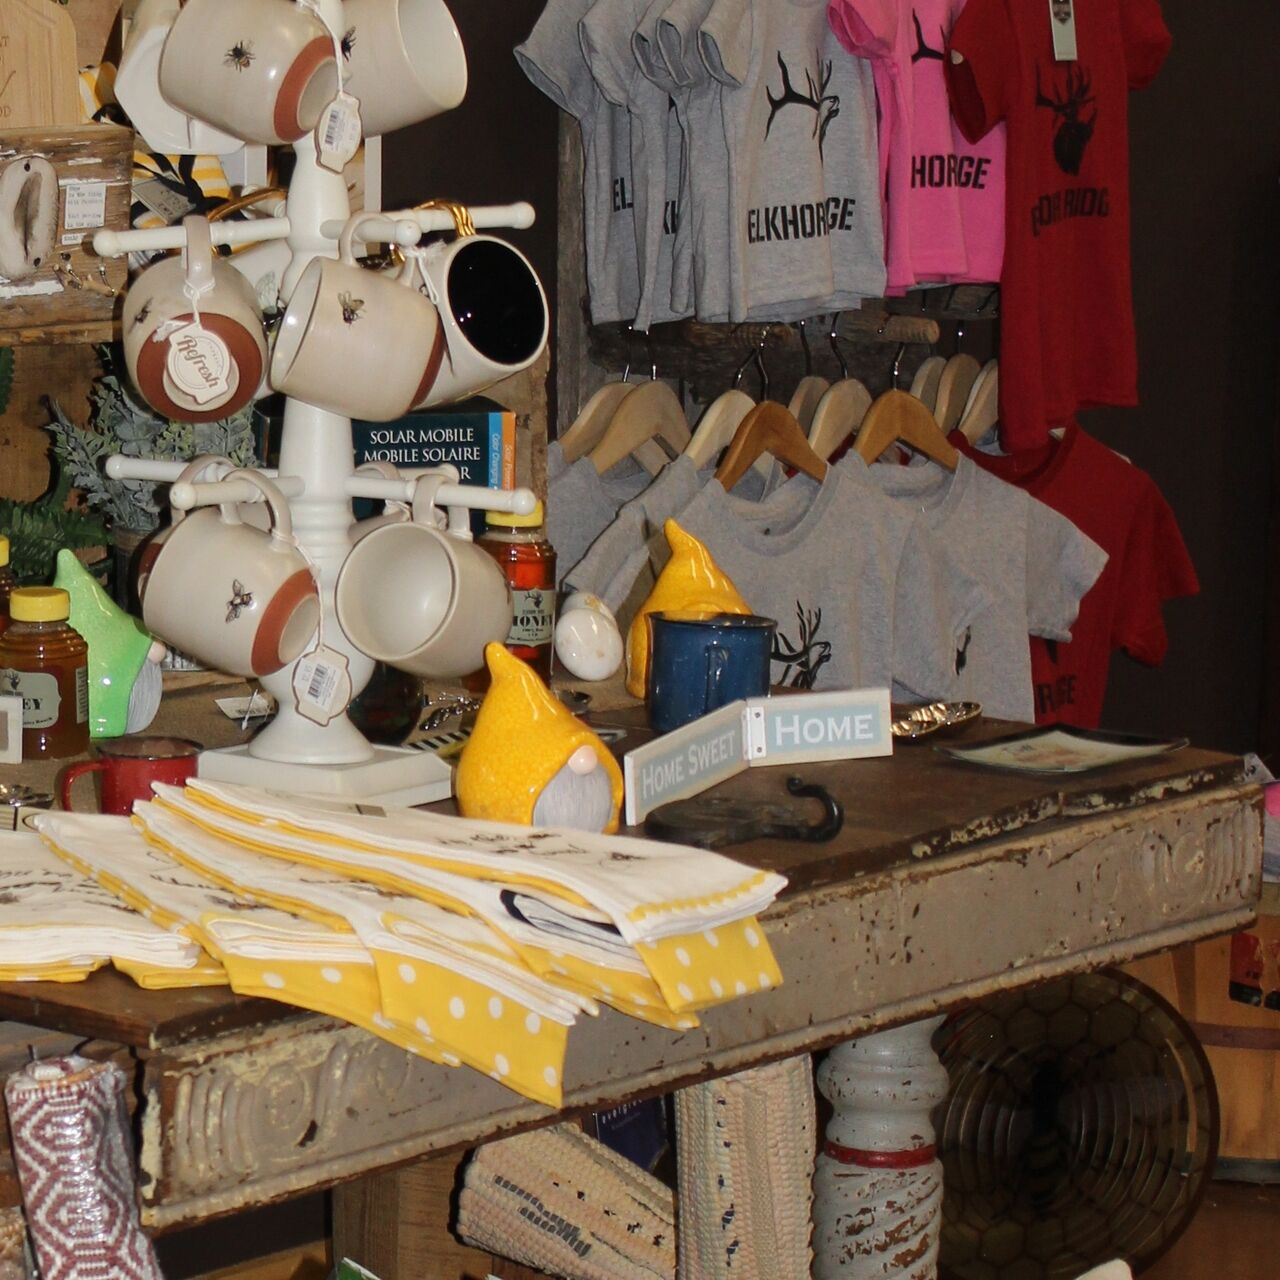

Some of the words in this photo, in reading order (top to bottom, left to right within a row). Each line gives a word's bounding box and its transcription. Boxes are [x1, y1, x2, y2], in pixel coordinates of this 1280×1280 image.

[176, 335, 220, 388] Refresh
[370, 430, 417, 445] SOLAR
[419, 428, 475, 443] MOBILE
[364, 449, 419, 463] MOBILE
[422, 447, 481, 462] SOLAIRE
[775, 714, 874, 746] HOME
[641, 755, 685, 800] HOME
[688, 730, 736, 776] SWEET
